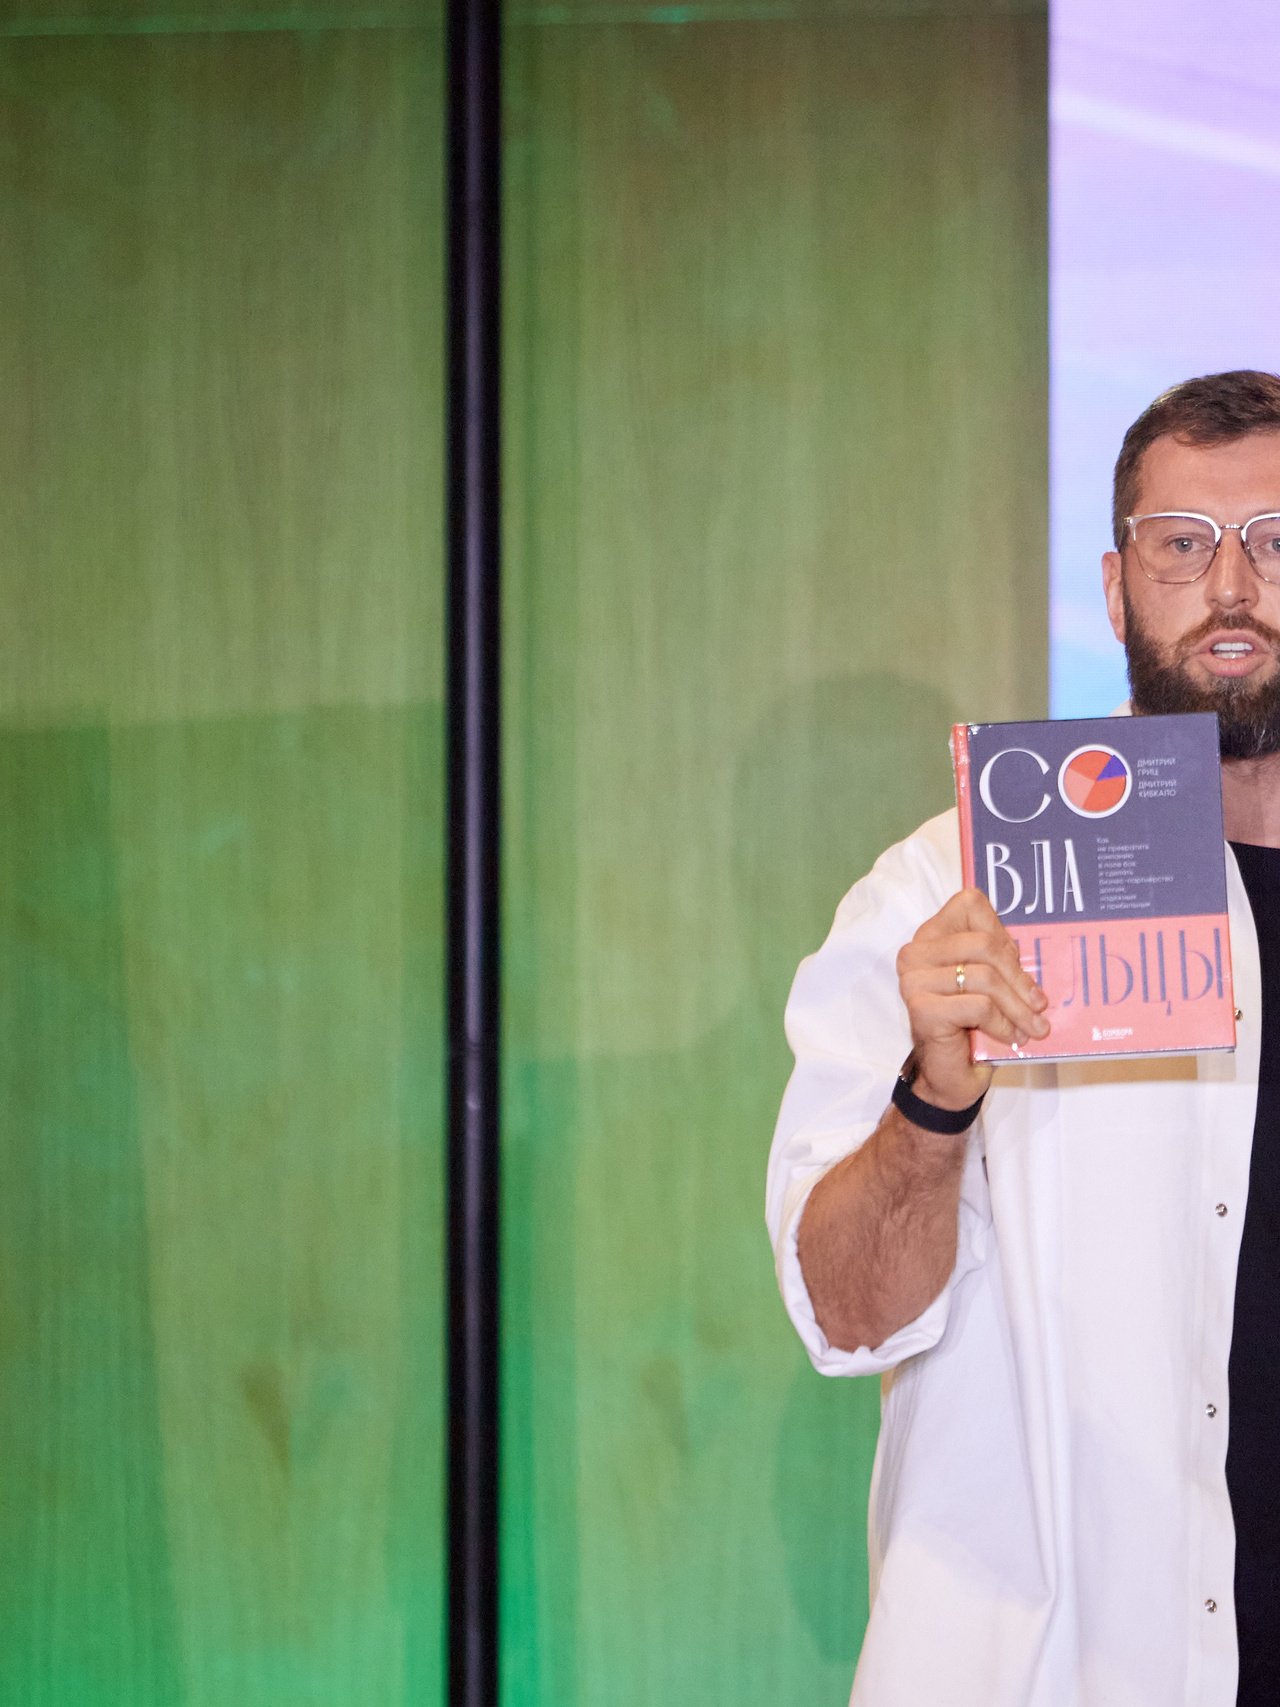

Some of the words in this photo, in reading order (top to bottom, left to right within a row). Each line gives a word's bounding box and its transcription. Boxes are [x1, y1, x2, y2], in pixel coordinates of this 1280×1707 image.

[1136, 757, 1177, 768] ДМИТРИЙ
[1137, 768, 1160, 777] ГРИЦ
[979, 743, 1133, 823] СО
[1137, 779, 1177, 790] ДМИТРИЙ
[1138, 788, 1178, 799] КИБКАЛО
[985, 838, 1085, 916] ВЛА
[1014, 928, 1223, 1016] ЕЛЬЦЫ
